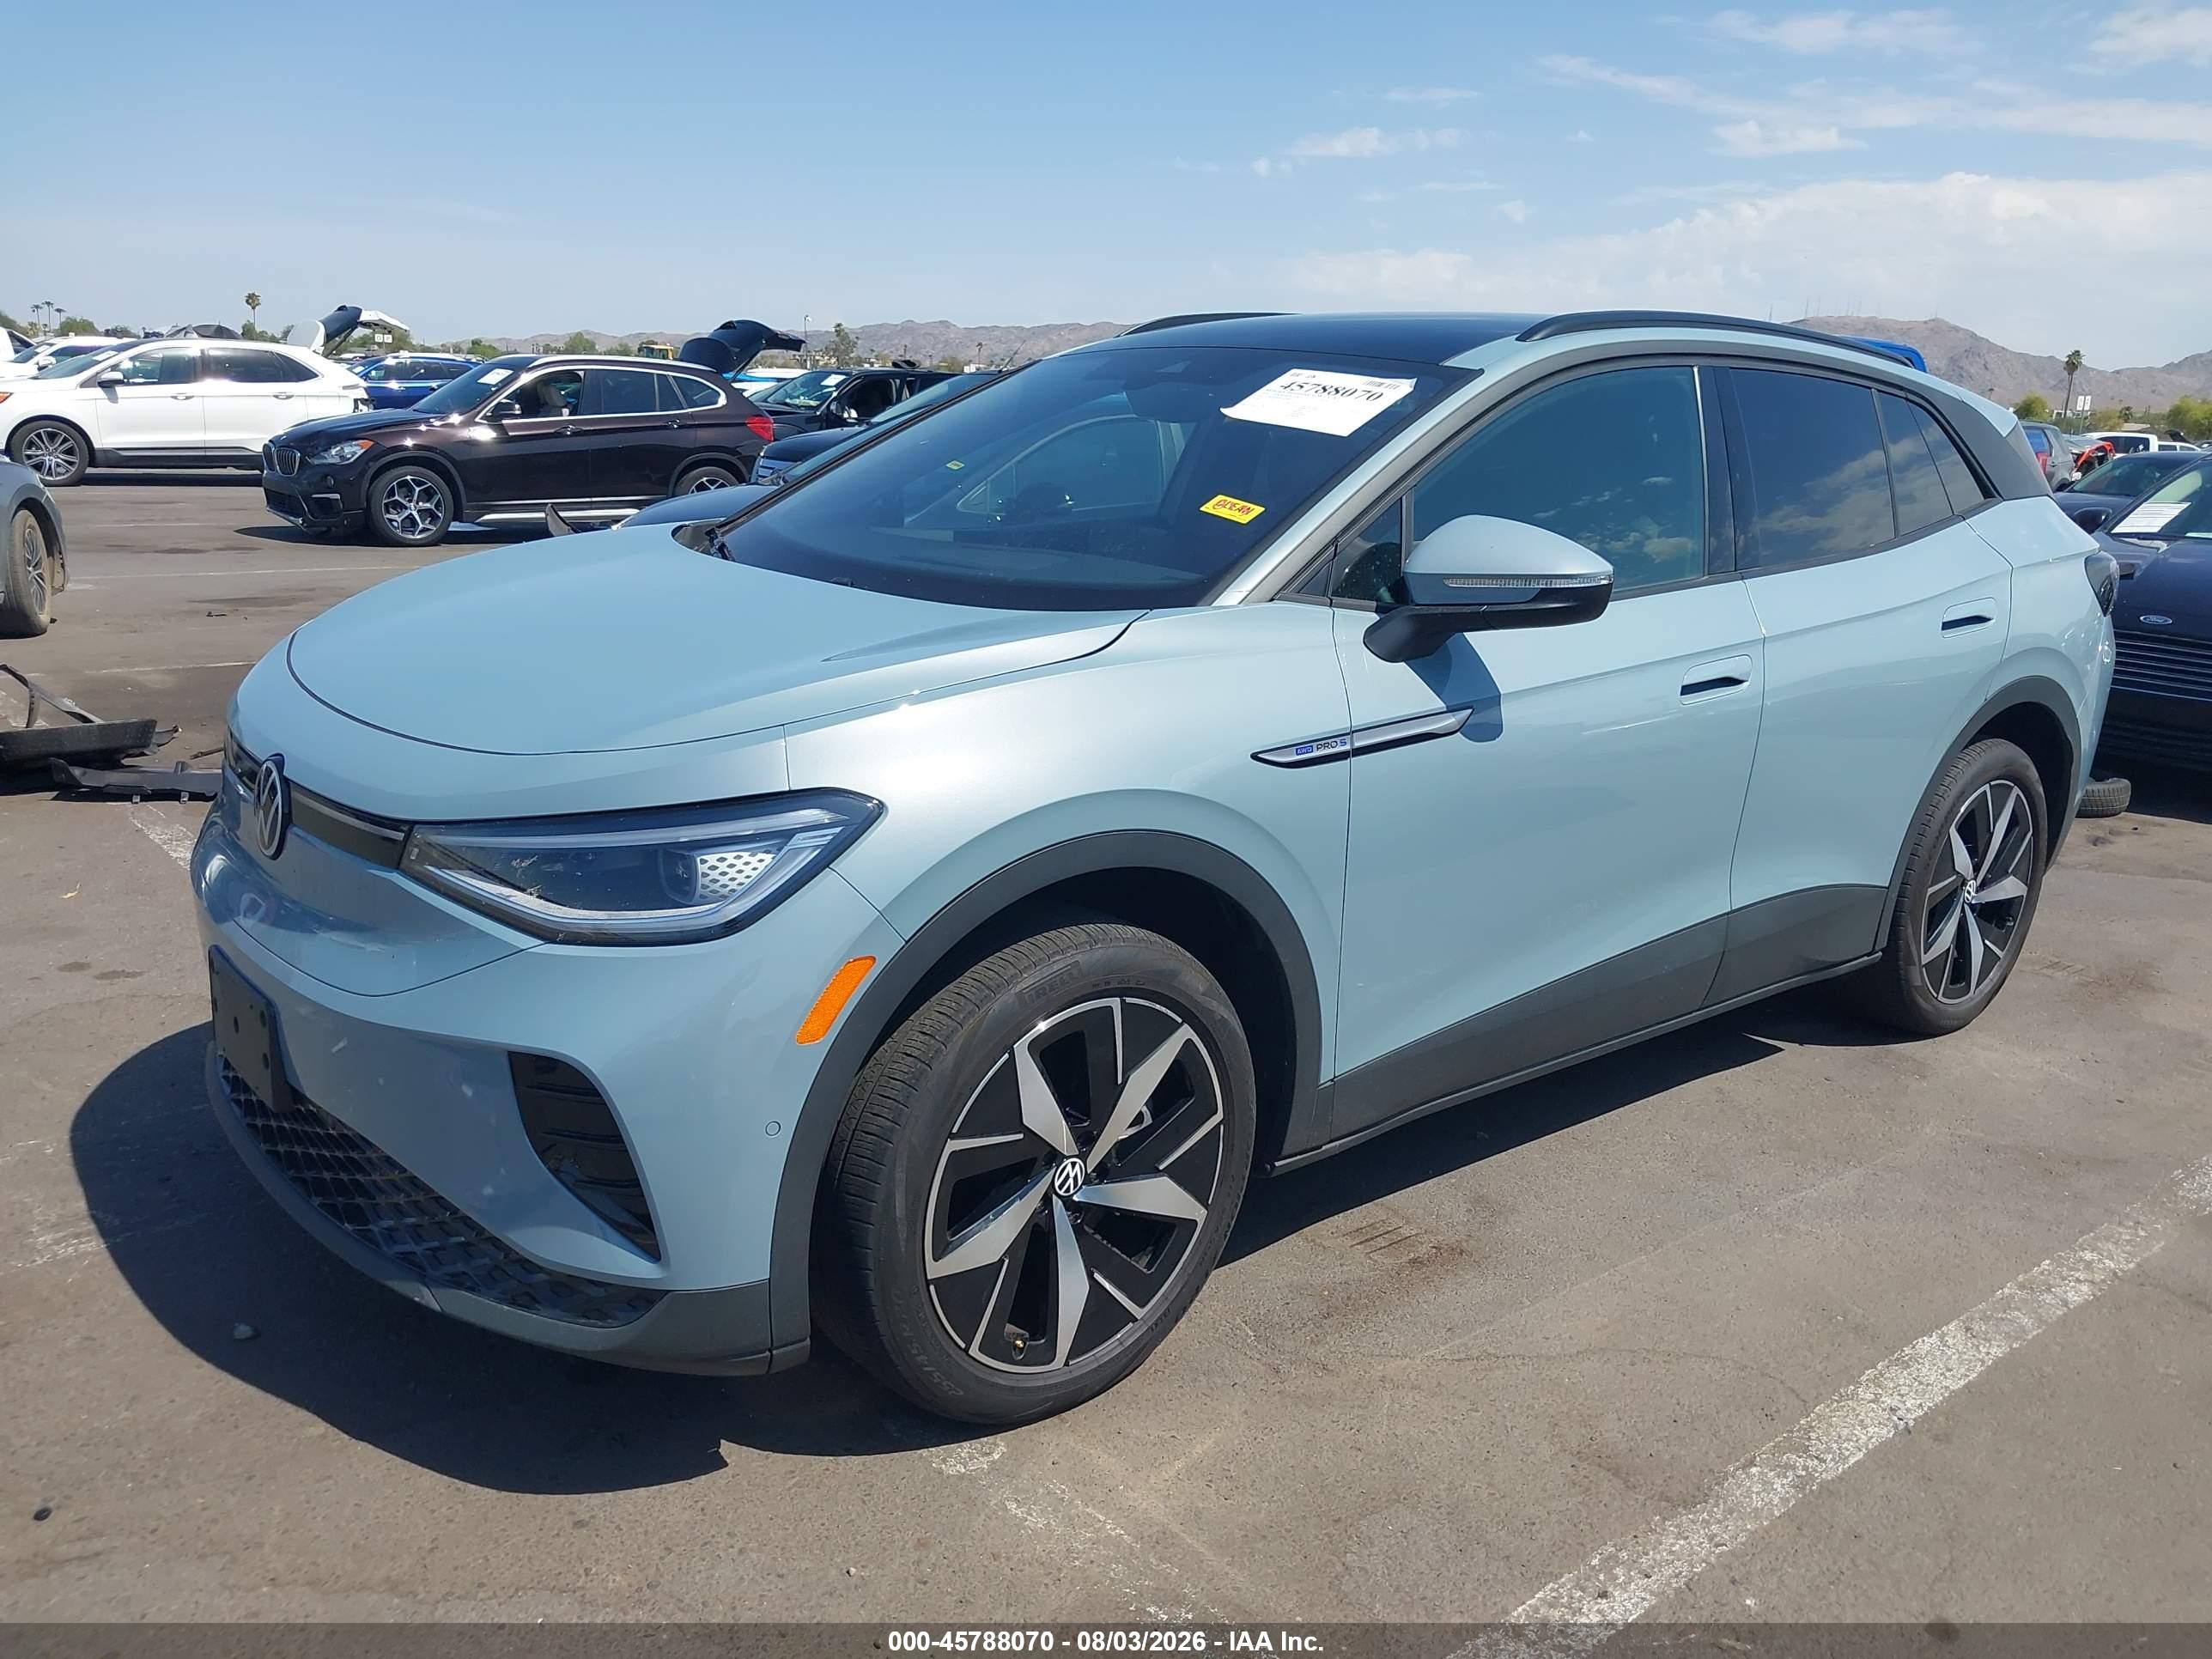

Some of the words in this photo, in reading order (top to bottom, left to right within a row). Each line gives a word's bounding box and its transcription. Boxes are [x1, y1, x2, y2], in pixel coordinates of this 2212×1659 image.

[1280, 381, 1384, 402] 45788070
[1297, 745, 1313, 755] AWD
[1316, 740, 1338, 751] PRO
[1340, 738, 1347, 747] S
